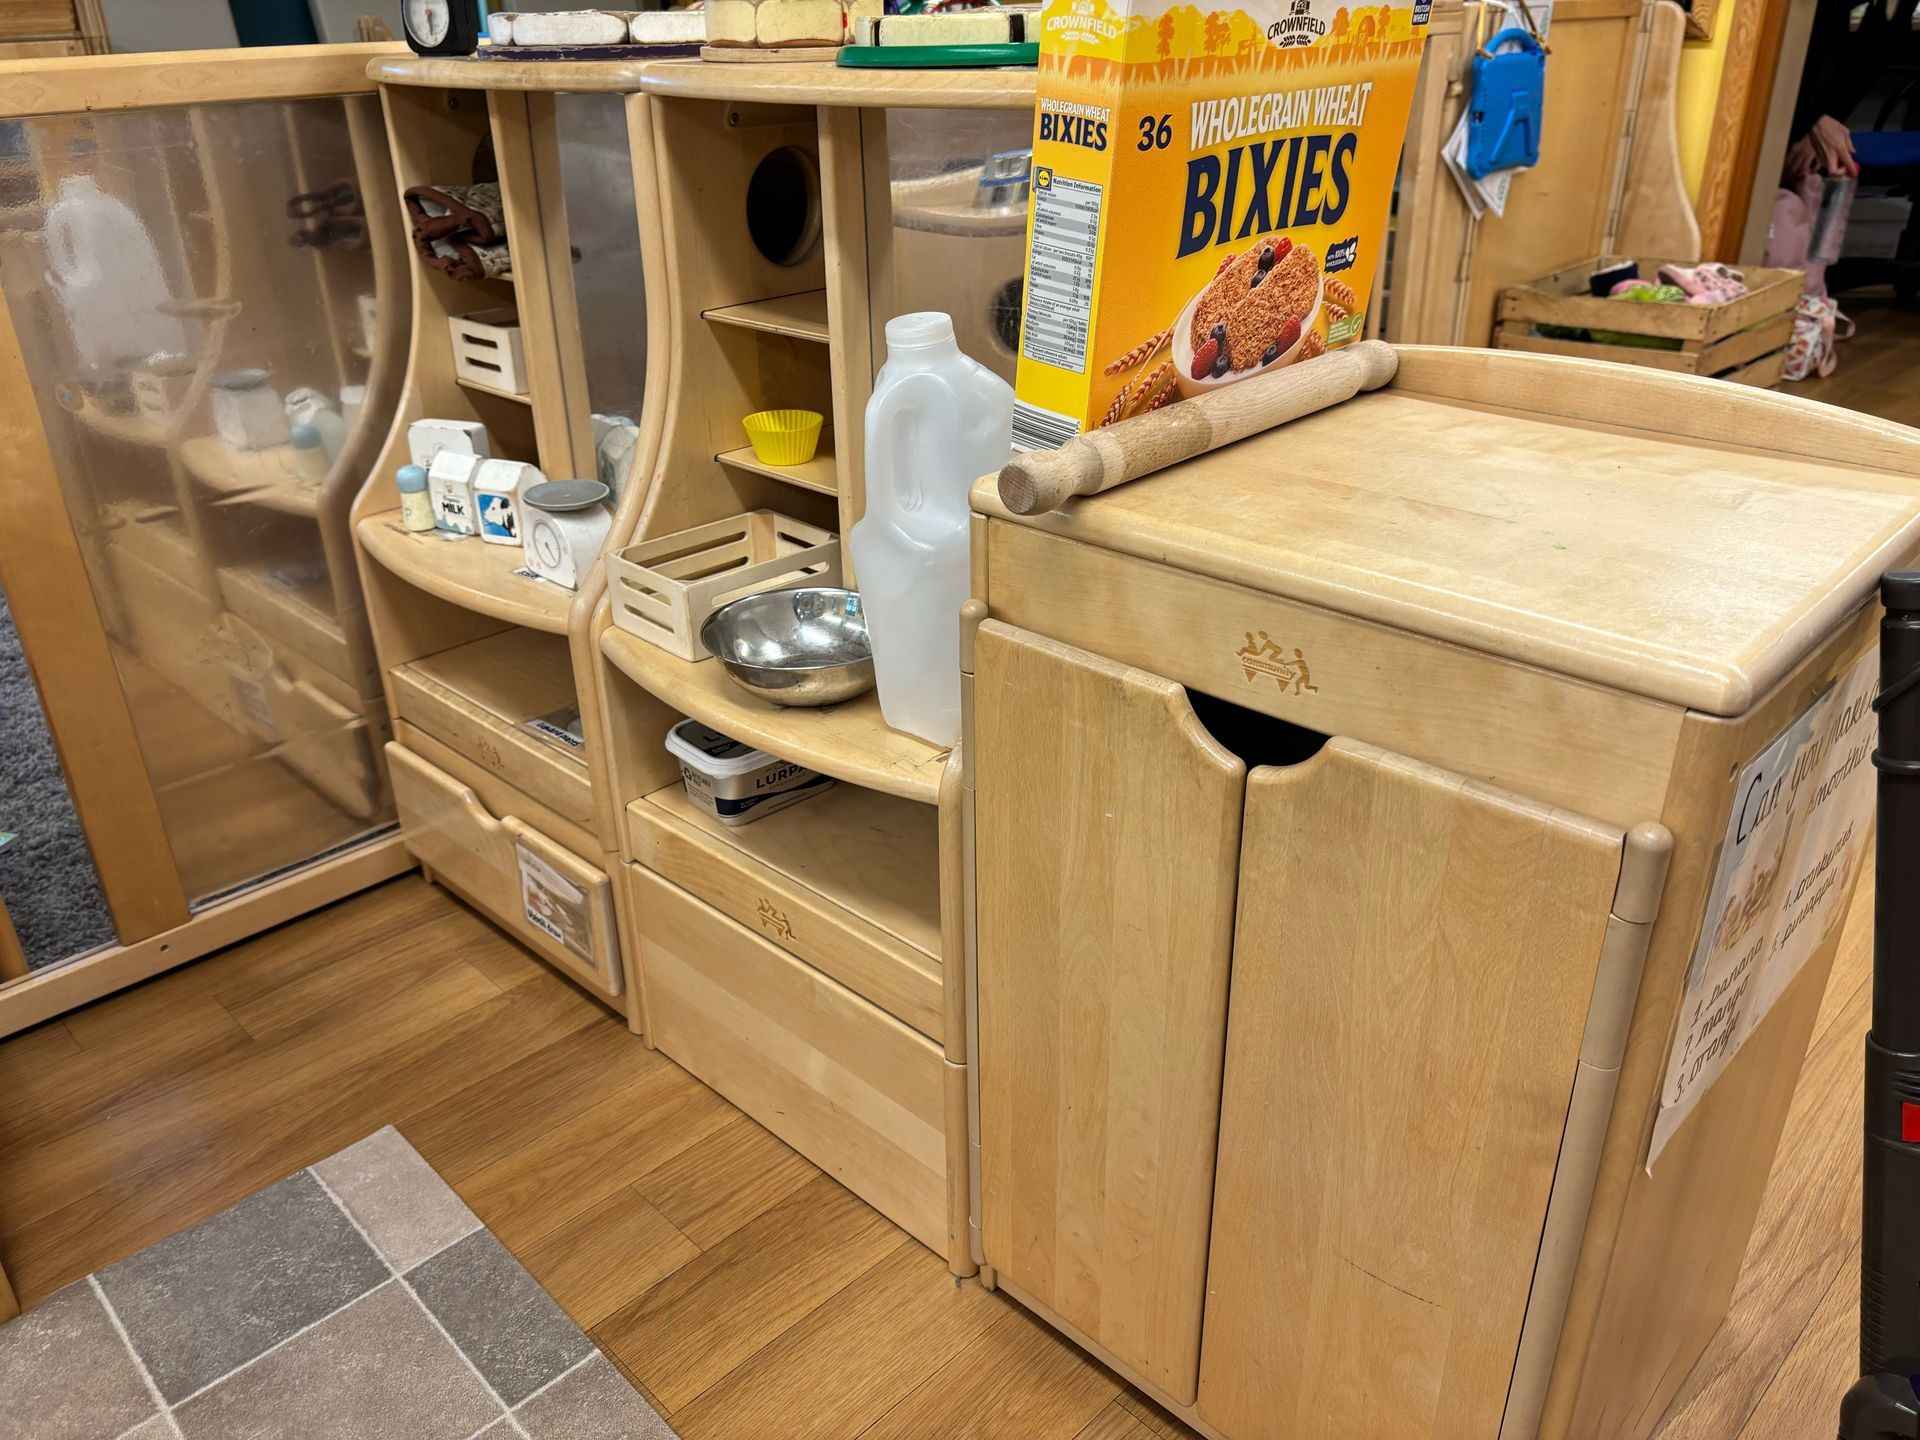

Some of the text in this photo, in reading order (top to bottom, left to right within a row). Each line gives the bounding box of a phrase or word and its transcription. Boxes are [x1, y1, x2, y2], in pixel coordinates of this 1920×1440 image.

[1047, 15, 1117, 39] CROWNFIELD
[1267, 16, 1325, 40] CROWNFIELD
[1413, 14, 1429, 23] WHEAT
[1041, 97, 1110, 121] WHOLEGRAIN WHEAT
[1191, 82, 1373, 151] WHOLEGRAIN WHEAT
[1040, 112, 1107, 151] BIXIES
[1137, 114, 1173, 151] 36
[1053, 178, 1101, 193] Nutrition Information
[1176, 133, 1357, 259] BIXIES
[442, 502, 464, 516] MILK
[1242, 656, 1296, 681] community
[1737, 772, 1781, 845] Can
[1786, 736, 1824, 815] you
[1706, 936, 1763, 1011] banana
[1695, 972, 1751, 1048] mango
[1688, 1011, 1740, 1085] orange
